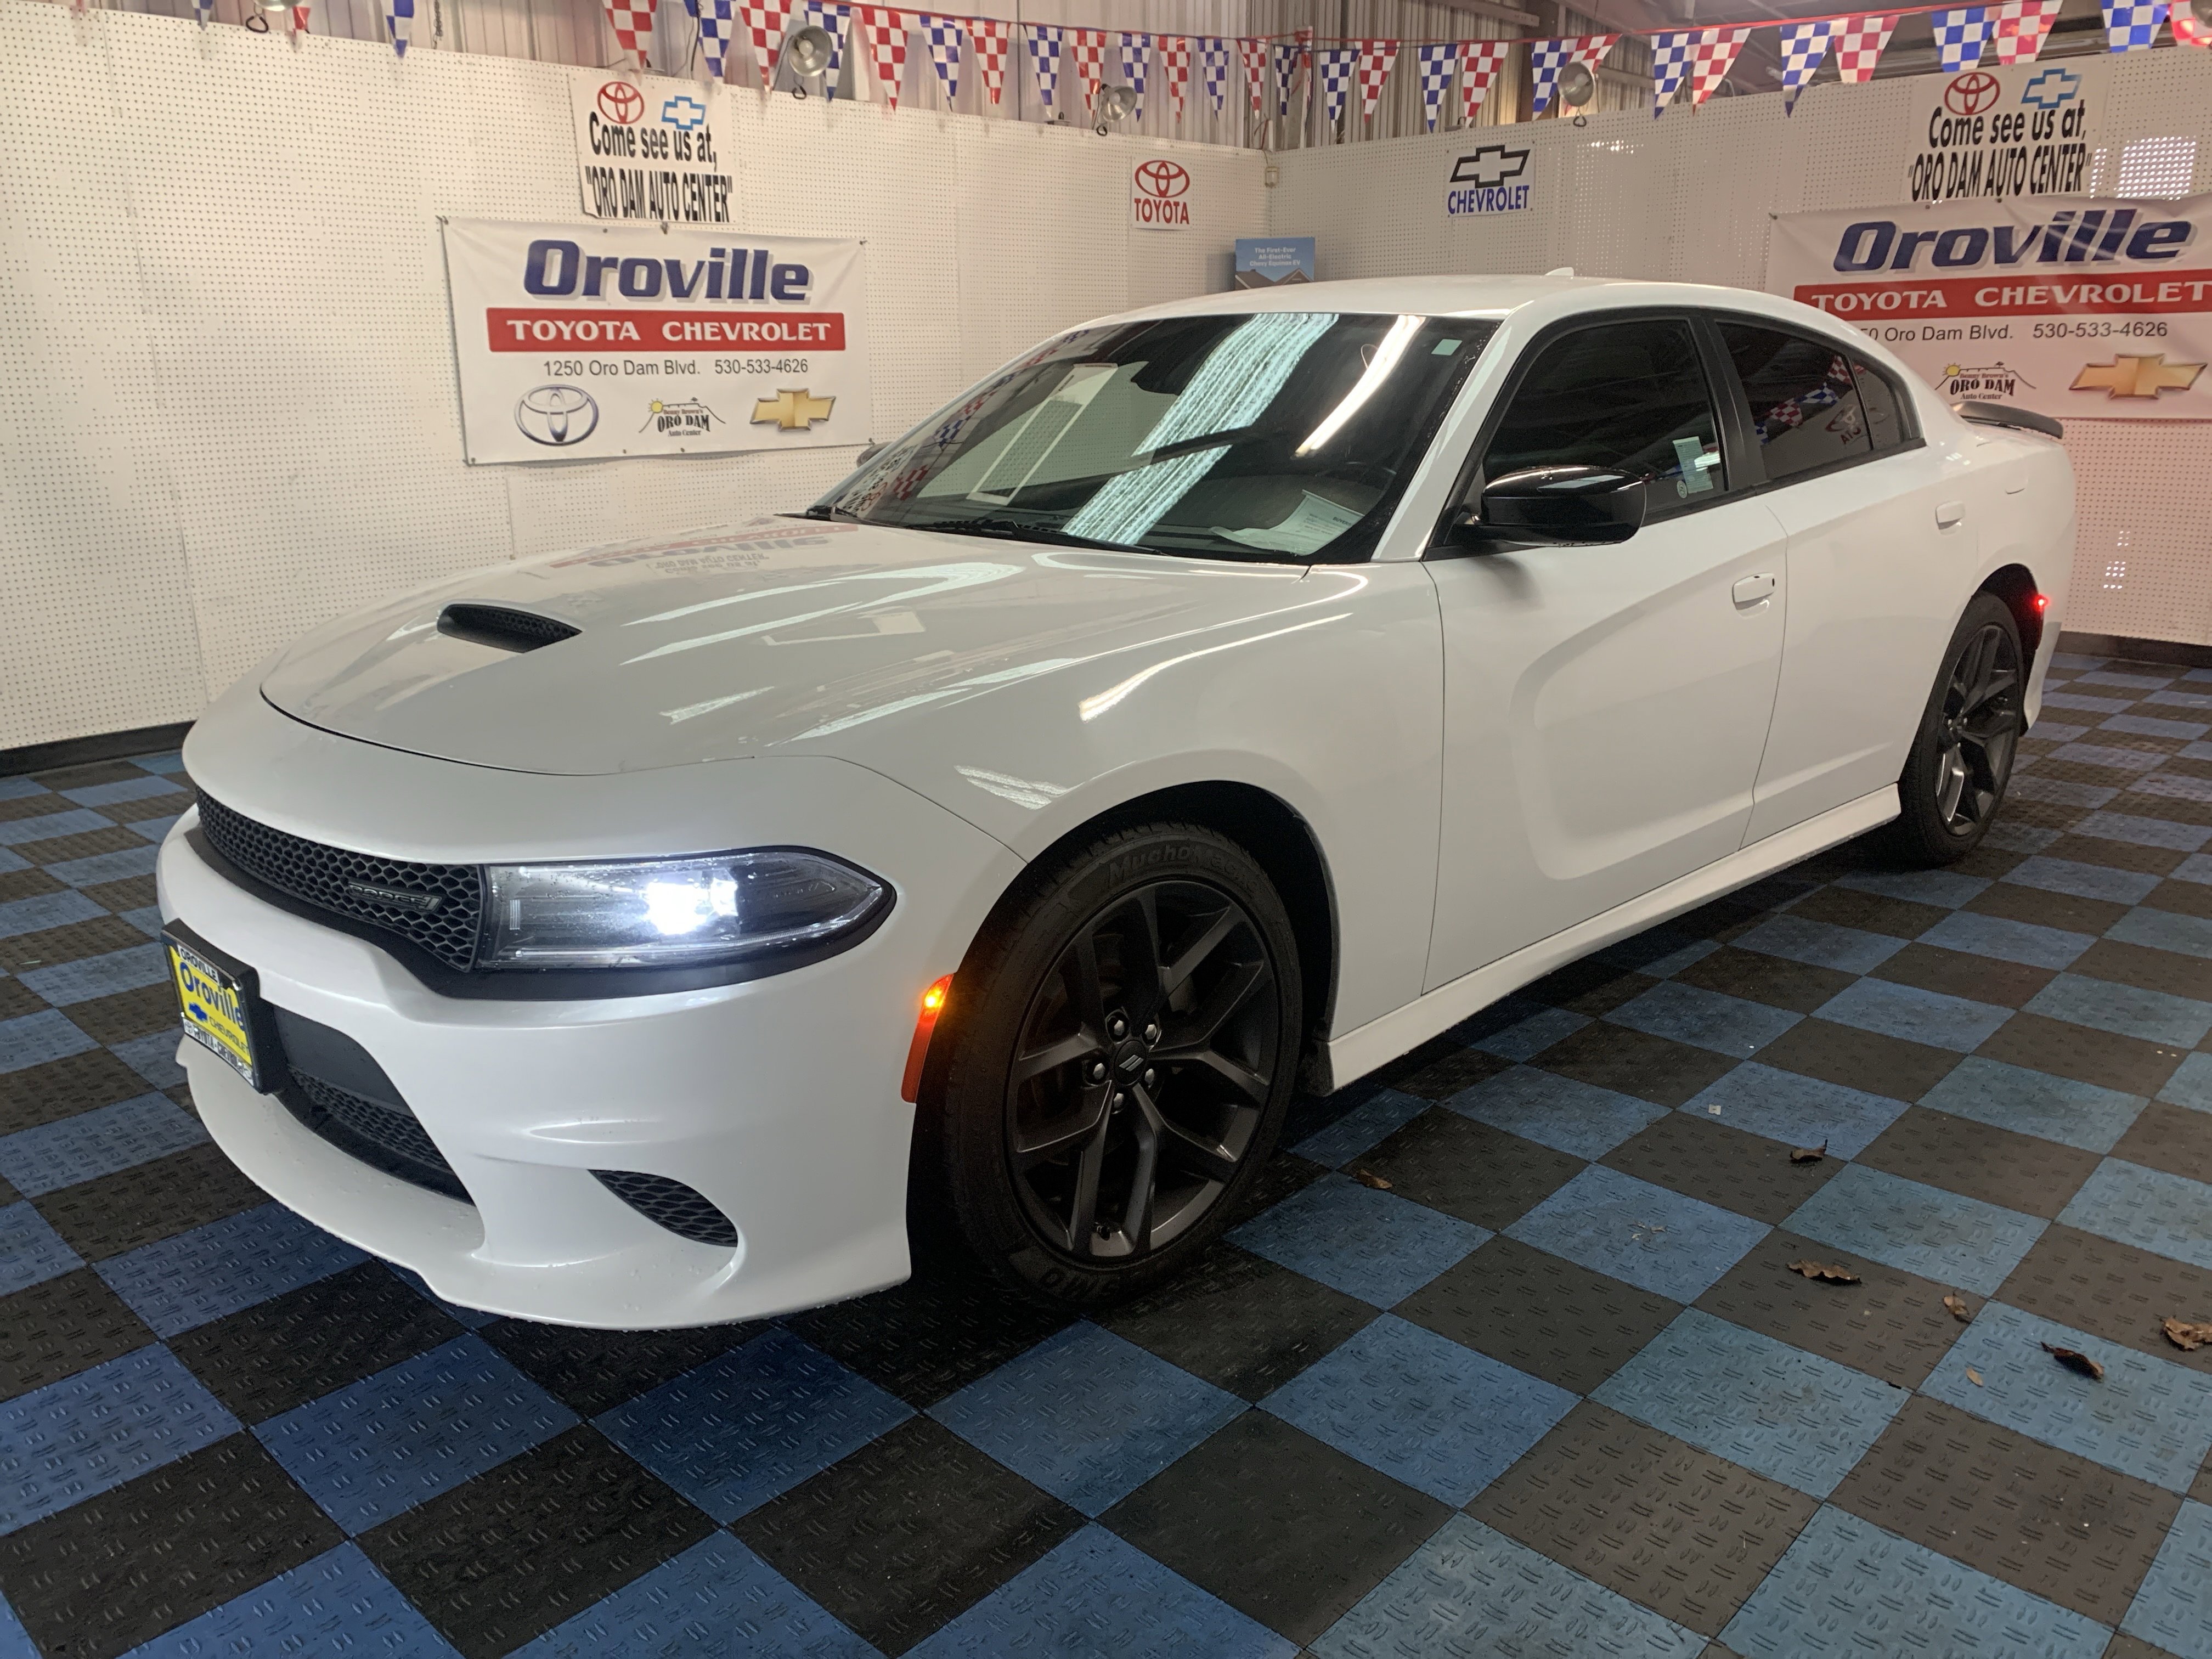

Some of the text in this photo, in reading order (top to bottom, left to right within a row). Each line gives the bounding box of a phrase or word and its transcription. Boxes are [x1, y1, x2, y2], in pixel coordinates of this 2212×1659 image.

[1929, 99, 2086, 148] Come see us at,
[589, 111, 717, 172] Come see us at,
[1946, 150, 1984, 199] DAM
[1984, 145, 2028, 196] AUTO
[619, 168, 646, 219] DAM
[649, 171, 679, 221] AUTO
[1448, 185, 1530, 215] CHEVROLET
[1134, 198, 1190, 225] TOYOTA
[1833, 208, 2192, 272] Oroville
[523, 239, 811, 301] Oroville
[1811, 280, 2212, 312] TOYOTA CHEVROLET
[507, 319, 831, 342] TOYOTA CHEVROLET
[1884, 327, 1916, 341] Oro
[1922, 326, 1962, 341] Dam
[1970, 324, 2013, 340] Blvd.
[2033, 321, 2168, 338] 530-533-4626
[543, 358, 809, 377] 1250 Oro Dam Blvd. 530-533-4626
[1950, 379, 2016, 396] ORO DAM
[657, 414, 710, 433] ORO DAM
[180, 947, 217, 980] OROVILLE
[180, 962, 245, 1031] Oroville
